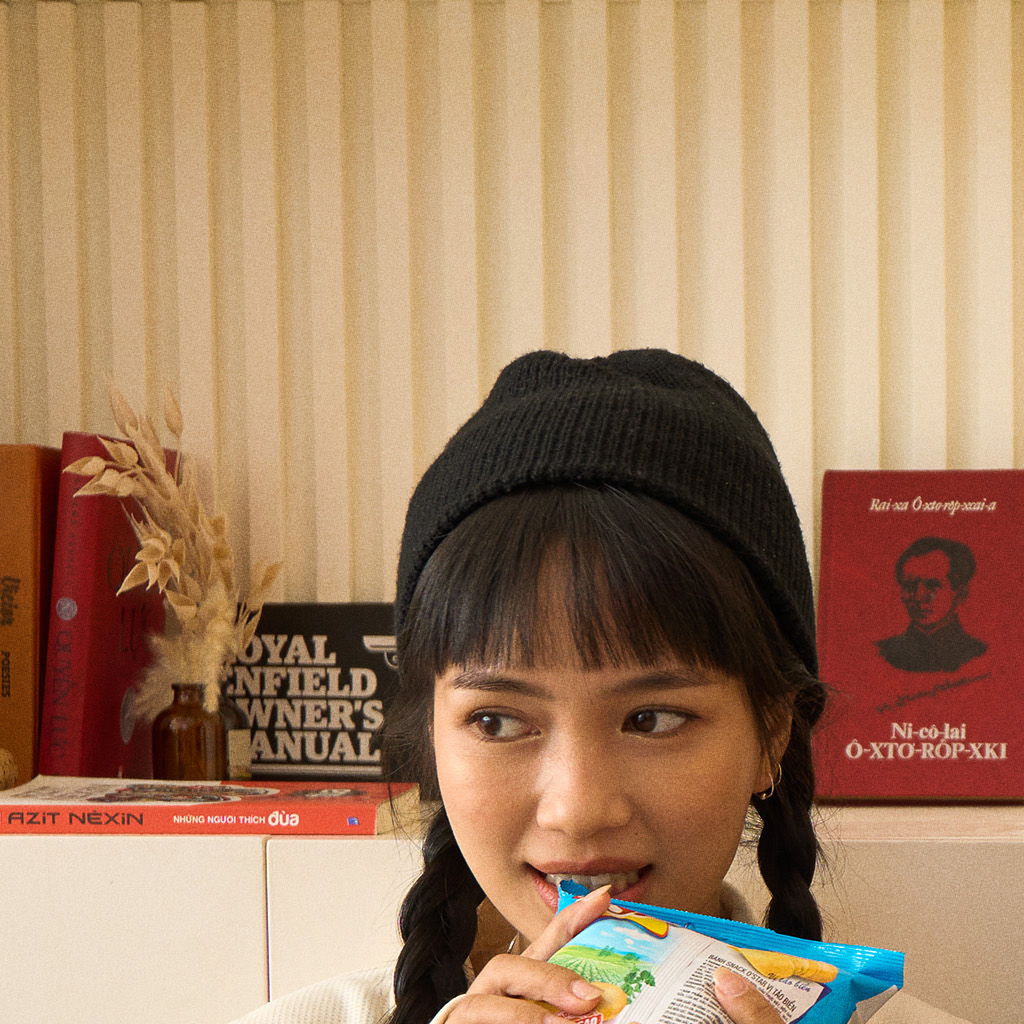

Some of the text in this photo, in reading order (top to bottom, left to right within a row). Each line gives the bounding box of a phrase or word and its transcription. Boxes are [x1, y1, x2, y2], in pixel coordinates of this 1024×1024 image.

[235, 633, 337, 666] OYAL
[236, 697, 384, 731] WNER'S
[250, 730, 381, 762] ANUAL
[890, 722, 967, 740] Ni-cô-lai
[267, 810, 300, 827] đùa
